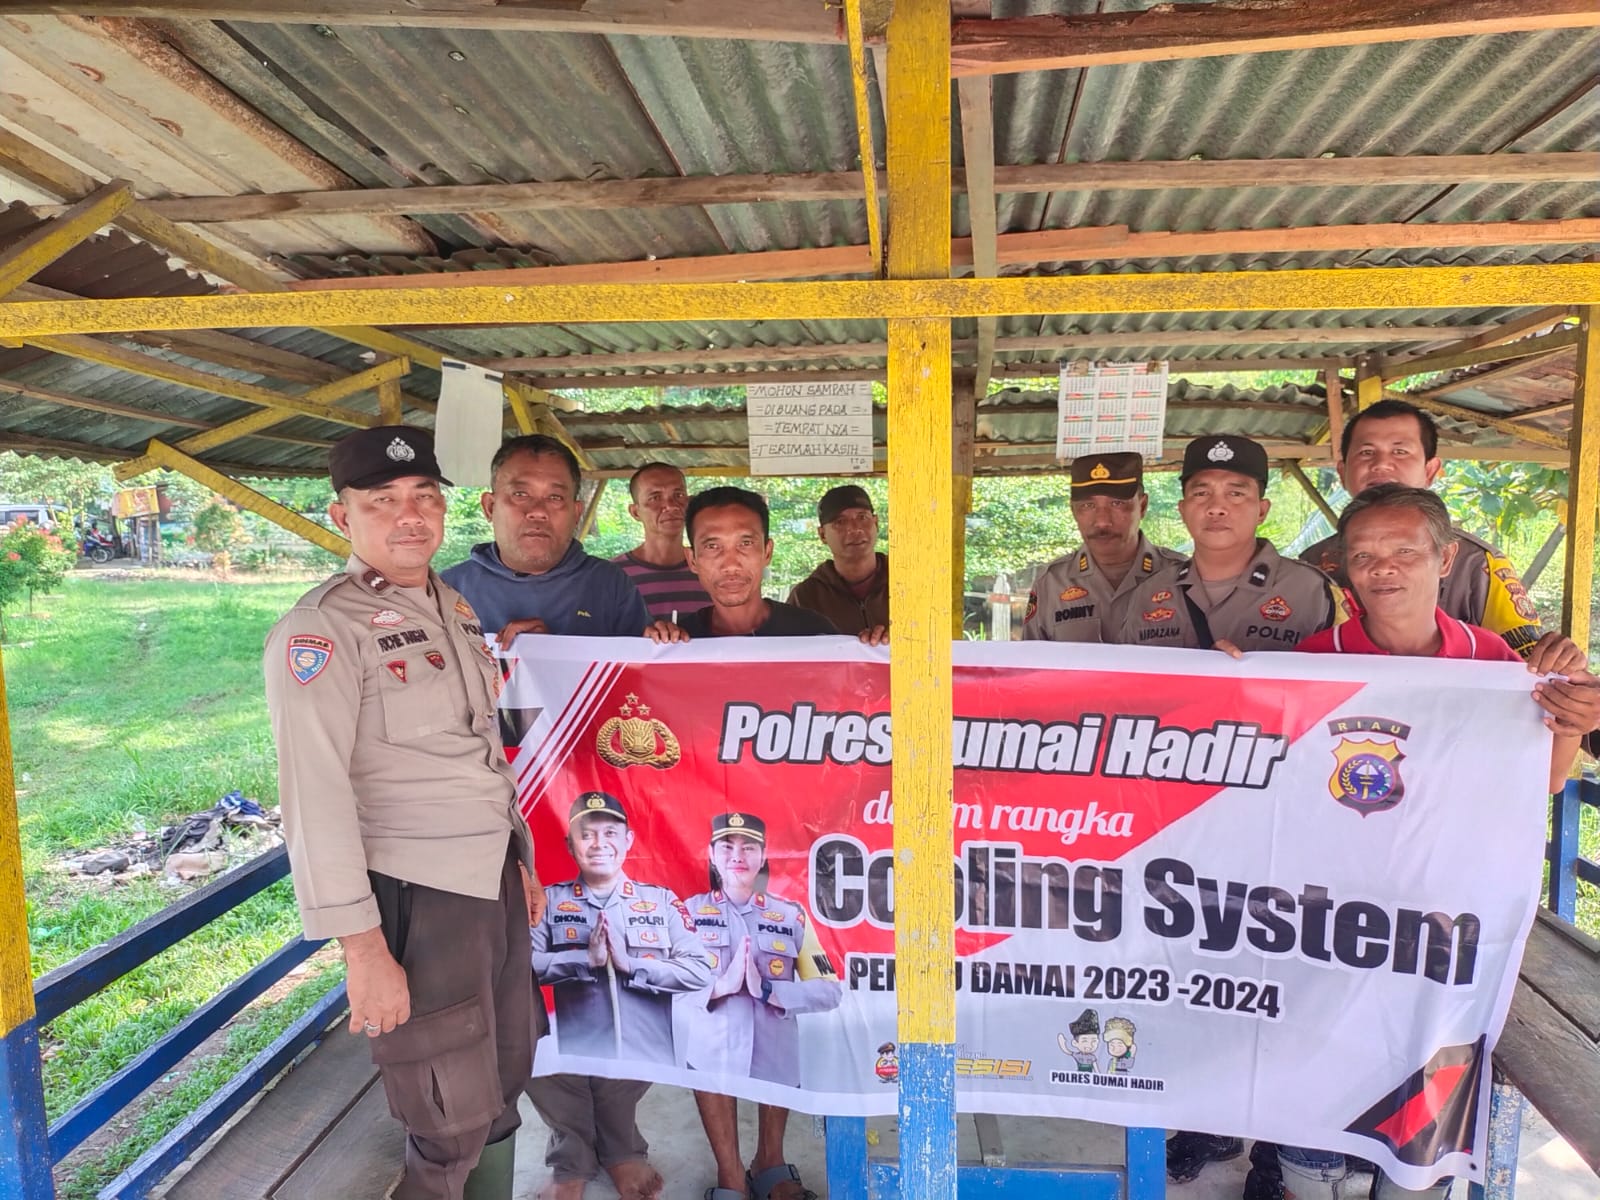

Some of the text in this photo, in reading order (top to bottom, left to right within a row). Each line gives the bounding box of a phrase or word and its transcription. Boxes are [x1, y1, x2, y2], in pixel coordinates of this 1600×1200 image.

[754, 384, 855, 397] MOHON SAMPAH
[818, 404, 848, 416] PADA
[822, 444, 858, 455] KASIH
[1246, 625, 1300, 644] POLRI
[1337, 720, 1401, 734] RIAU
[720, 702, 1286, 789] Polres umai Hadir
[989, 801, 1134, 845] rangka
[628, 915, 665, 926] POLRI
[815, 839, 1481, 986] Coling System
[758, 924, 793, 936] POLRI
[971, 961, 1075, 998] DAMAI
[1083, 965, 1170, 1001] 2023
[955, 1058, 1032, 1076] ESISI
[1051, 1071, 1164, 1091] POLRES DUMAI HADIR
